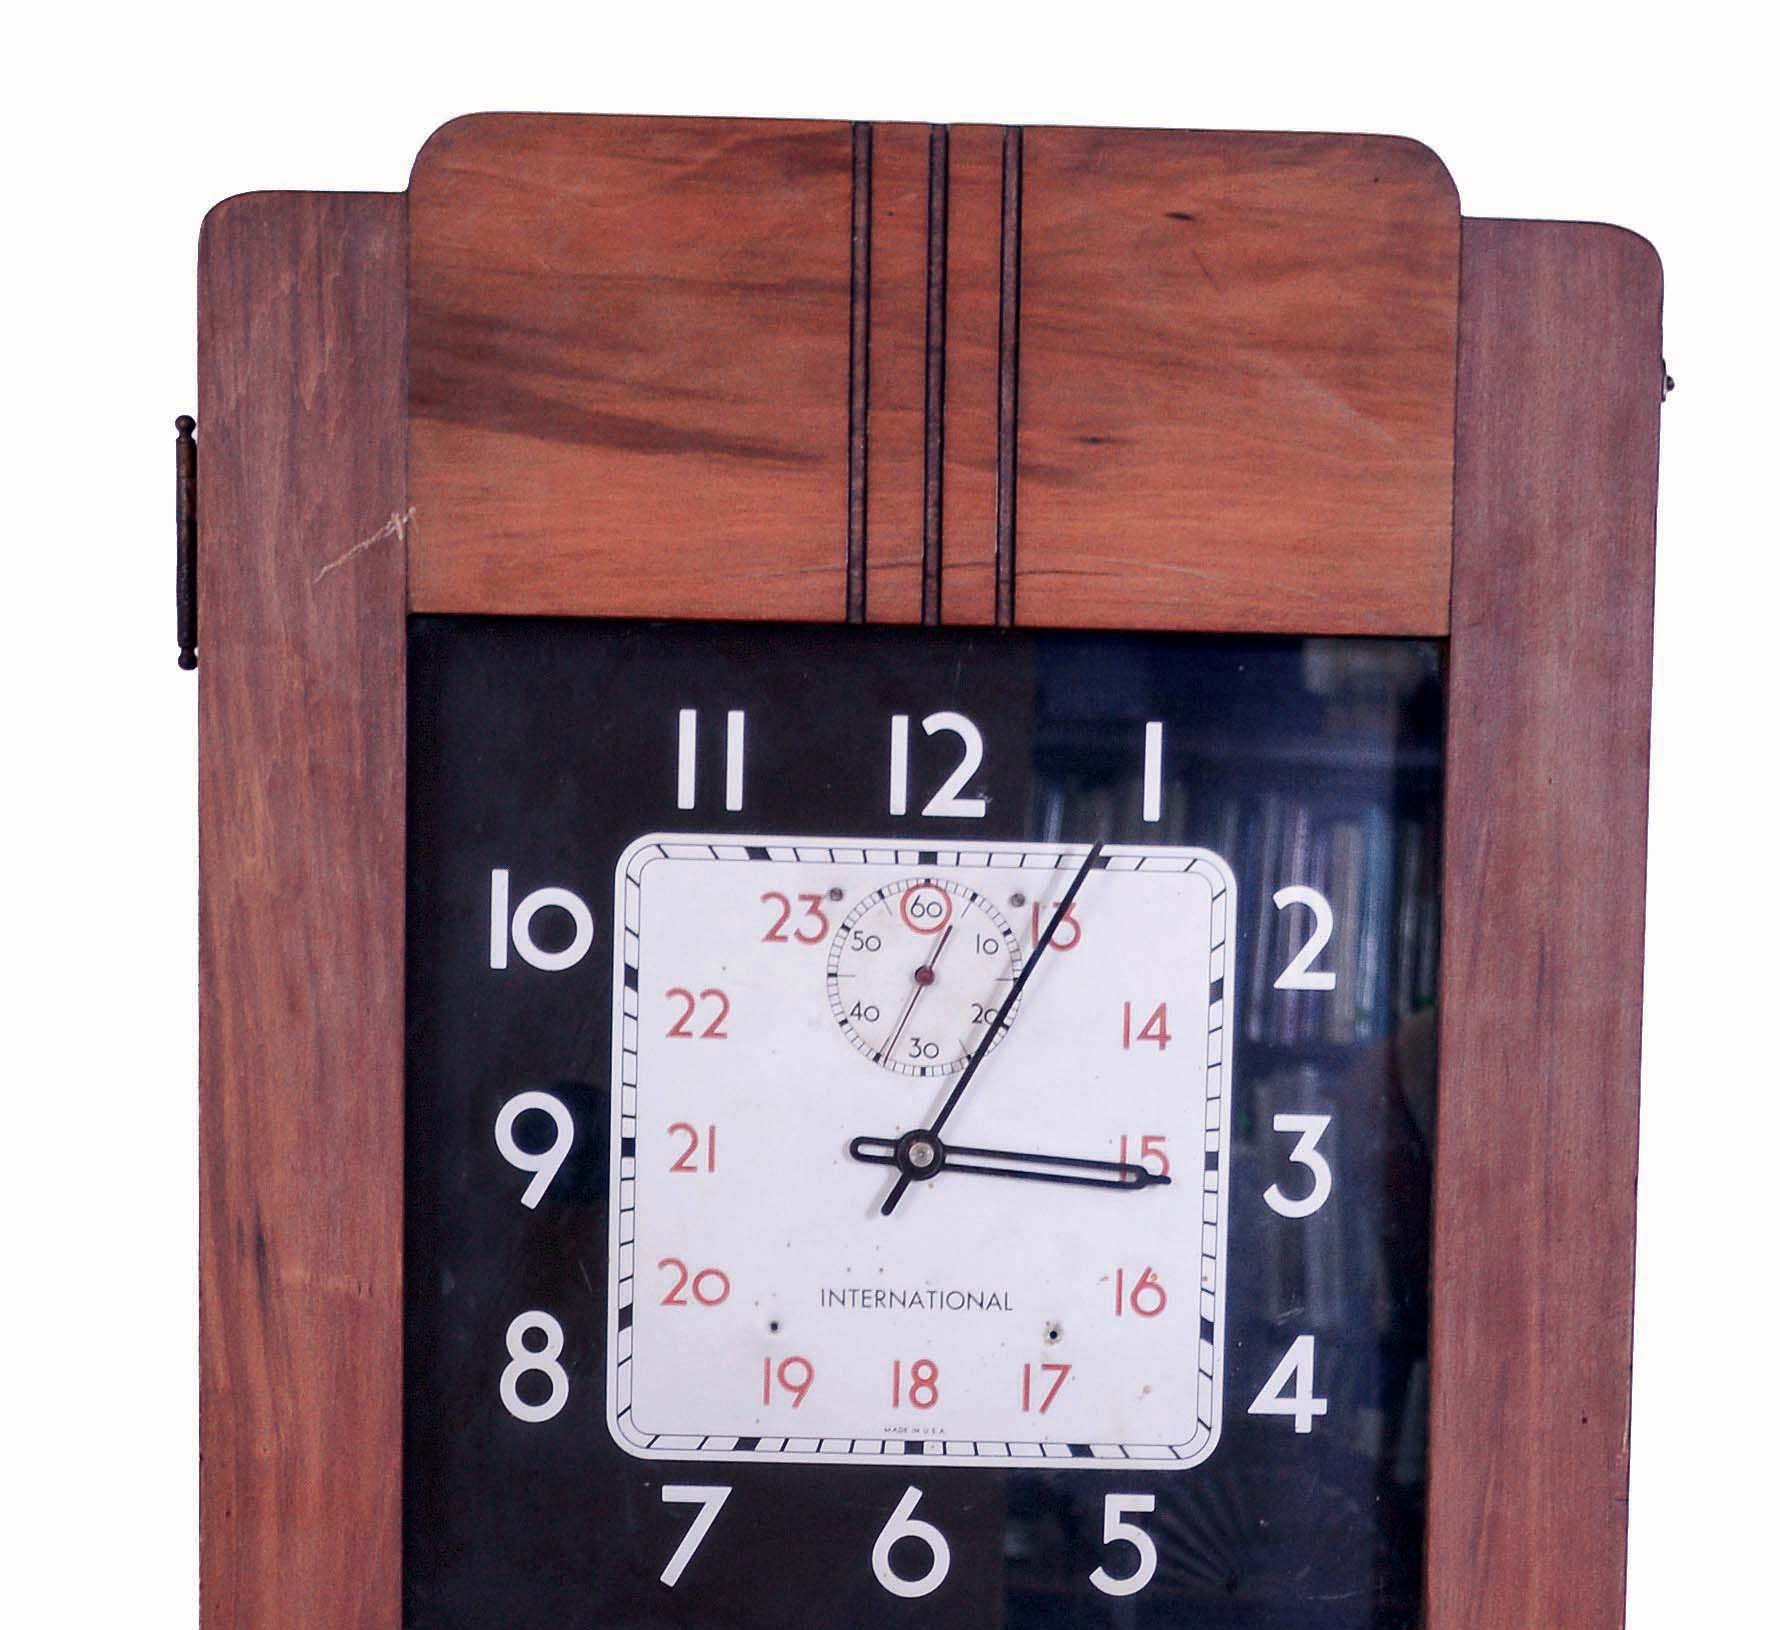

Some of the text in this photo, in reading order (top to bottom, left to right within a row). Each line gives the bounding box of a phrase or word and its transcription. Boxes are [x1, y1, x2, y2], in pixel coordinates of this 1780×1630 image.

[677, 709, 745, 811] 11
[889, 711, 987, 818] 12
[1143, 721, 1163, 822] 1
[490, 868, 595, 971] 10
[760, 891, 830, 944] 23
[910, 895, 943, 918] 60
[1031, 901, 1082, 951] 13
[851, 930, 881, 952] 50
[976, 933, 999, 955] 10
[1272, 885, 1337, 991] 2
[665, 988, 731, 1040] 22
[850, 1001, 880, 1022] 40
[1122, 1002, 1172, 1050] 14
[909, 1038, 939, 1059] 30
[494, 1091, 575, 1210] 9
[667, 1122, 717, 1174] 21
[1120, 1134, 1170, 1187] 15
[1263, 1113, 1333, 1219] 3
[658, 1258, 731, 1307] 20
[820, 1287, 1013, 1312] INTERNATIONAL
[1115, 1267, 1167, 1318] 16
[499, 1310, 570, 1423] 8
[763, 1355, 815, 1408] 19
[892, 1359, 939, 1410] 18
[1021, 1363, 1072, 1415] 17
[1247, 1335, 1328, 1434] 4
[660, 1485, 733, 1588] 7
[871, 1485, 951, 1598] 6
[1089, 1493, 1158, 1597] 5
